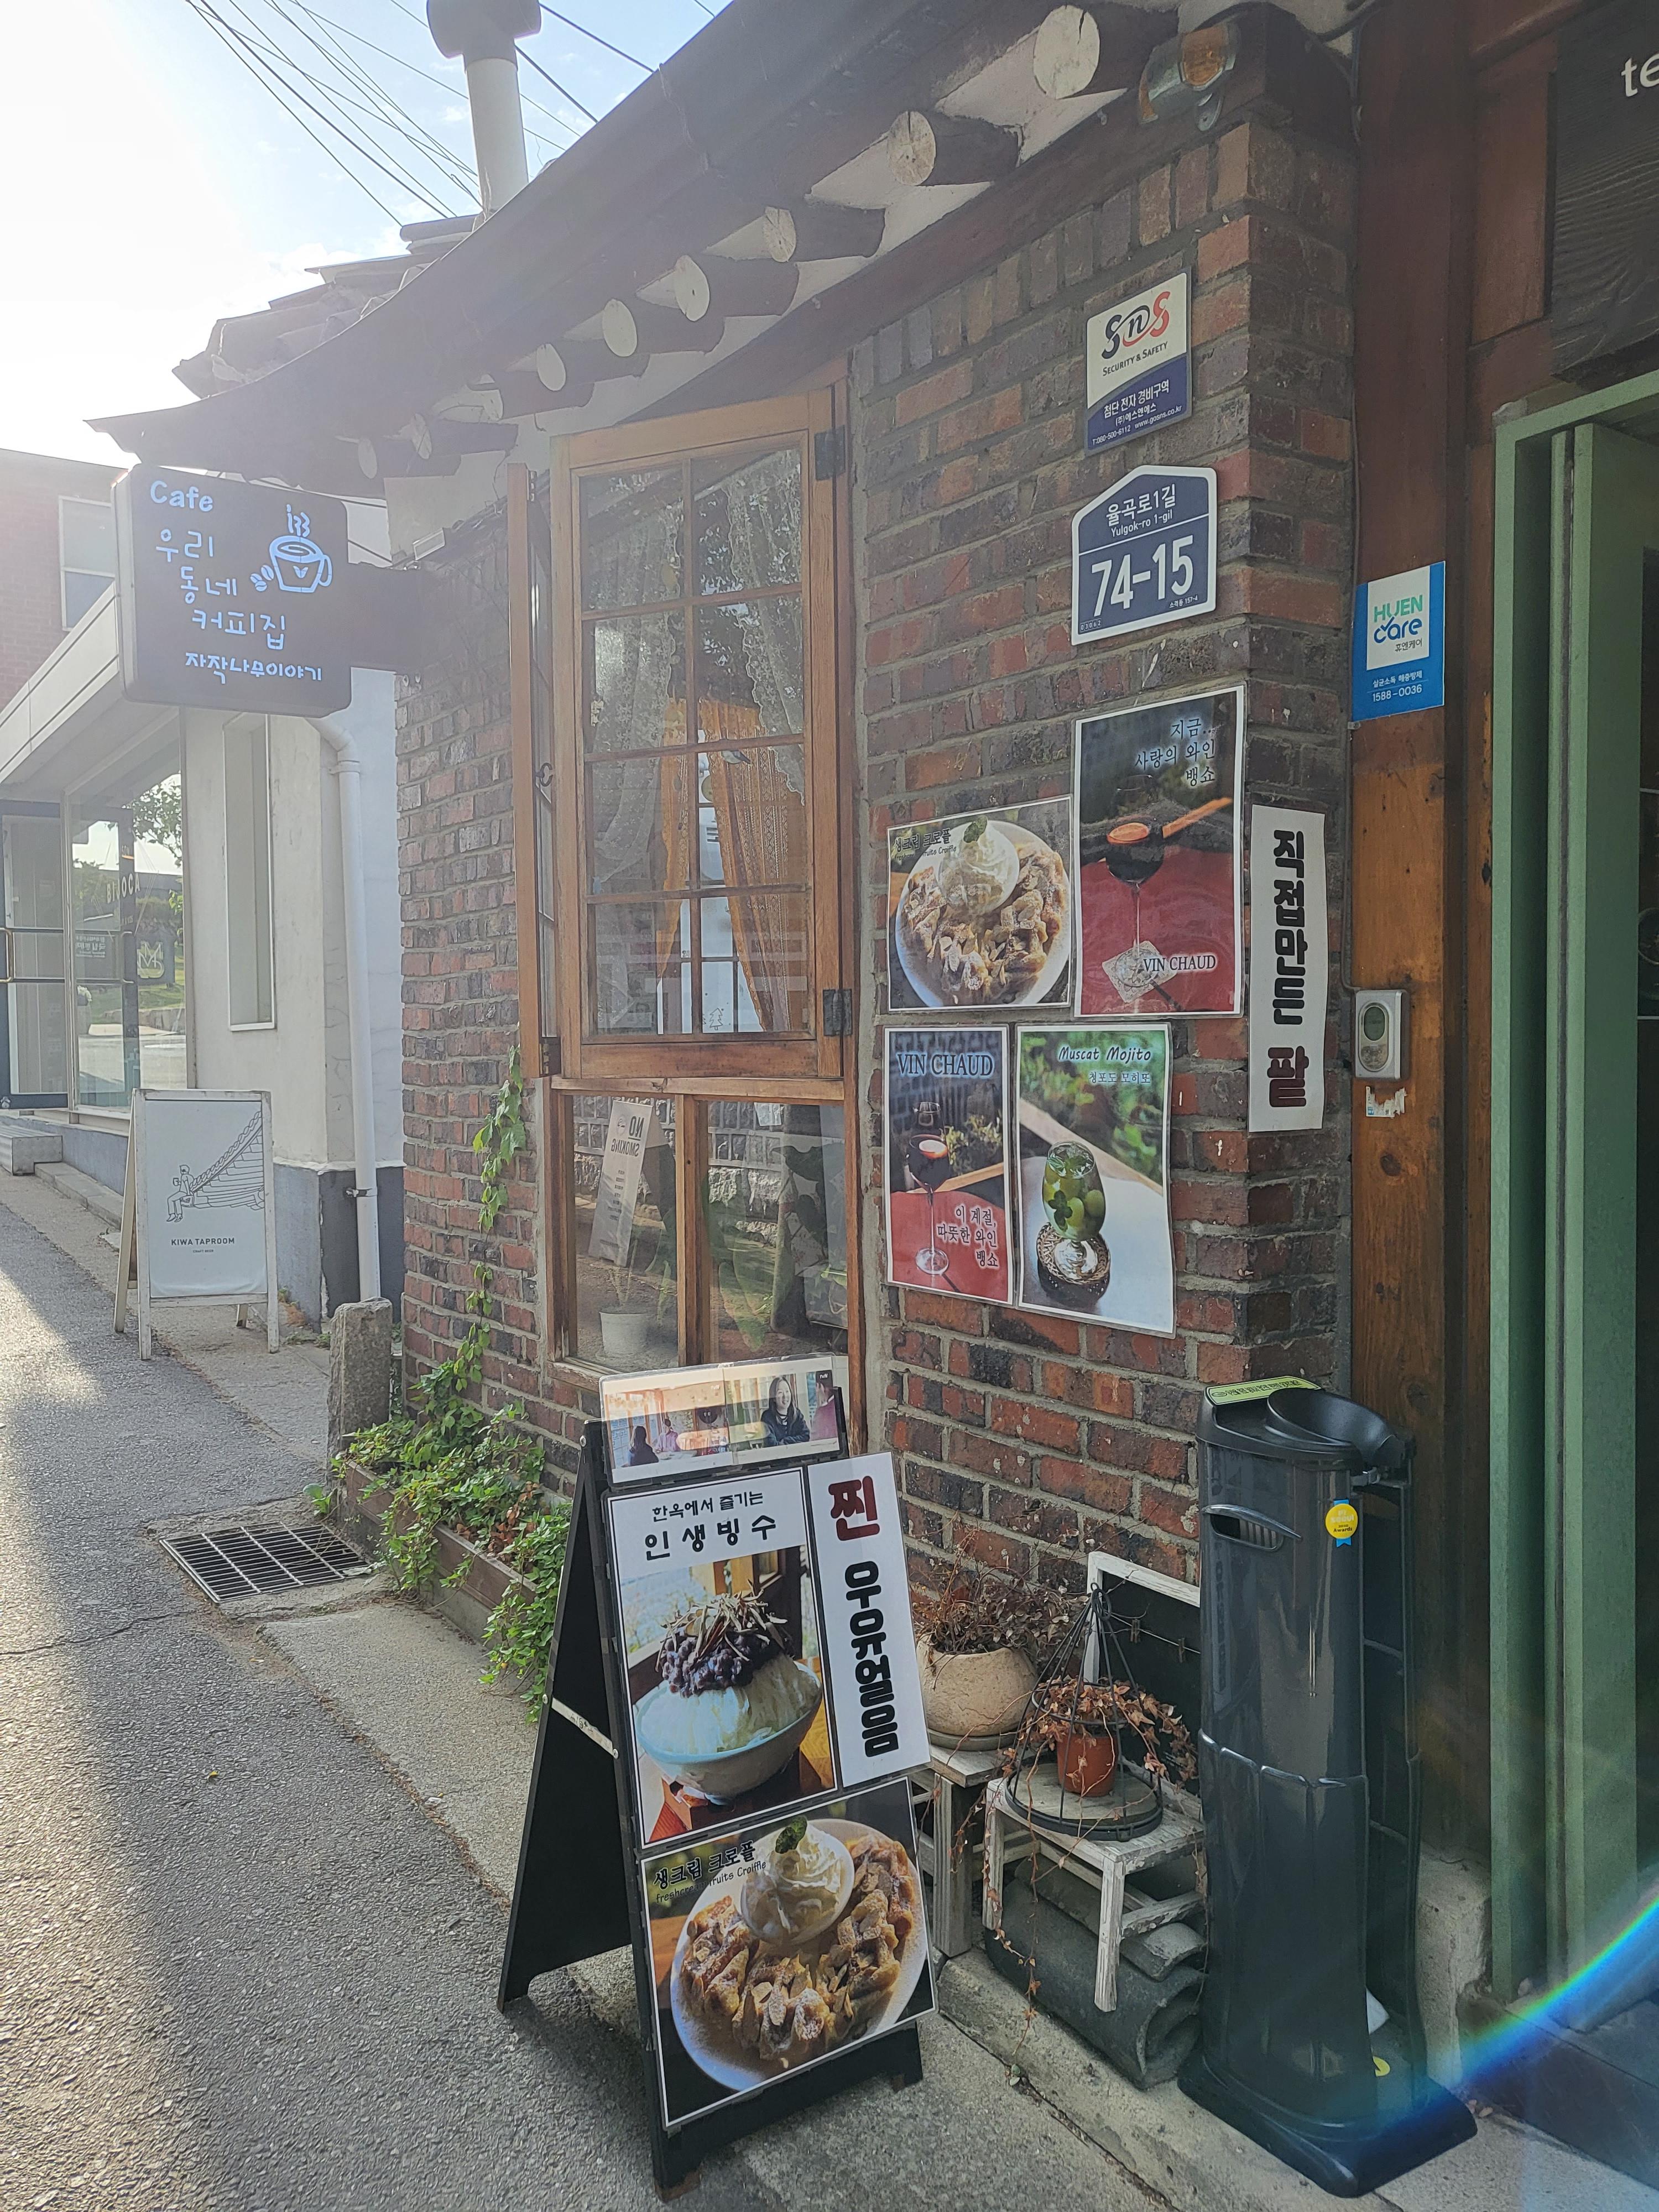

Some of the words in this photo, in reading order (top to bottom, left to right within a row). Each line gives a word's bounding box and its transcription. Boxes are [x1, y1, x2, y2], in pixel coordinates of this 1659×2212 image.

[1102, 356, 1135, 377] SECURITY
[1142, 341, 1168, 359] SAFETY
[1104, 400, 1120, 419] 첨단
[1120, 393, 1136, 411] 전자
[1138, 379, 1169, 405] 경비구역
[1115, 403, 1156, 427] (주)에스엔에스
[1134, 405, 1182, 429] www.gosns.co.kr
[150, 479, 213, 512] Cafe
[1106, 484, 1176, 526] 율곡로1길
[1111, 518, 1151, 538] Yulgok-ro
[1154, 510, 1173, 525] 1-gil
[155, 529, 213, 562] 우리
[181, 566, 237, 604] 동네
[1092, 535, 1194, 617] 74-15
[1374, 594, 1423, 623] HUEN
[192, 609, 285, 650] 커피집
[1080, 619, 1102, 632] 03062
[185, 652, 322, 685] 자작나무이야기
[1373, 676, 1396, 688] 살균소독
[1398, 670, 1423, 682] 해충방제
[1372, 684, 1422, 702] 1588-0036
[1135, 744, 1177, 770] 사랑의
[1186, 738, 1215, 762] 와인
[1186, 766, 1215, 786] 뱅쇼
[893, 833, 919, 852] 생크림
[923, 828, 951, 846] 크로플
[107, 873, 140, 903] BIJOCA
[1273, 830, 1308, 1025] 직접만든
[1142, 957, 1165, 973] VIN
[1169, 954, 1217, 971] CHAUD
[897, 1053, 926, 1074] VIN
[931, 1053, 993, 1076] CHAUD
[1058, 1046, 1099, 1060] Muscat
[1106, 1046, 1151, 1065] Mojito
[1089, 1071, 1117, 1084] 청포도
[1121, 1072, 1151, 1084] 모히또
[1266, 1045, 1310, 1108] 팥
[956, 1206, 964, 1223] 이
[971, 1207, 996, 1228] 계절,
[195, 1237, 235, 1245] TAPROOM
[937, 1223, 971, 1244] 따뜻한
[975, 1228, 997, 1248] 와인
[976, 1250, 999, 1267] 뱅쇼
[652, 1498, 713, 1522] 한옥에서
[719, 1491, 763, 1511] 즐기는
[828, 1475, 880, 1541] 찐
[844, 1560, 899, 1757] 우유얼음
[653, 1857, 702, 1890] 생크림
[708, 1840, 756, 1872] 크로플
